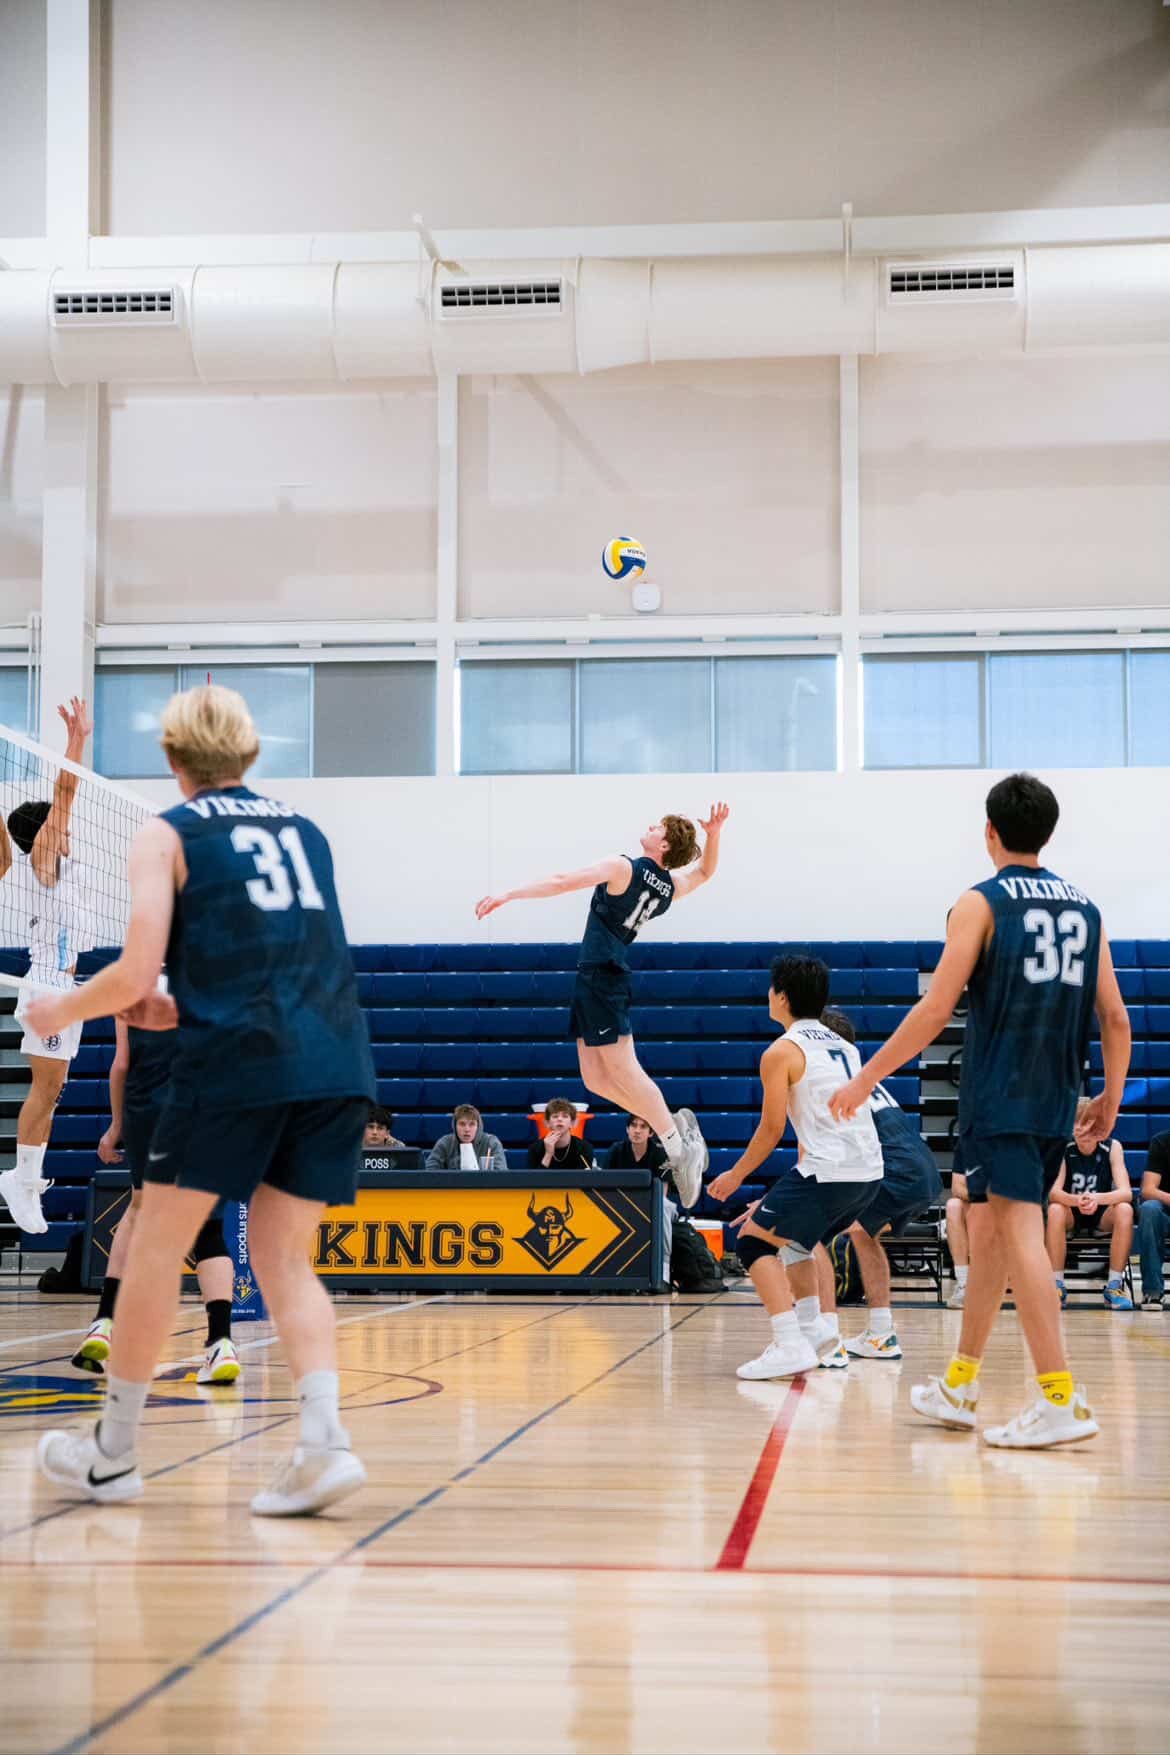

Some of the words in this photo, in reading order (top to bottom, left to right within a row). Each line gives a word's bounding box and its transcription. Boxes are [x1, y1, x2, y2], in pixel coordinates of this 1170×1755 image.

[184, 796, 302, 818] VIKING
[230, 825, 325, 911] 31
[1023, 908, 1088, 987] 32
[365, 1158, 389, 1169] POSS
[1071, 1173, 1098, 1195] 22
[236, 1221, 248, 1265] imports
